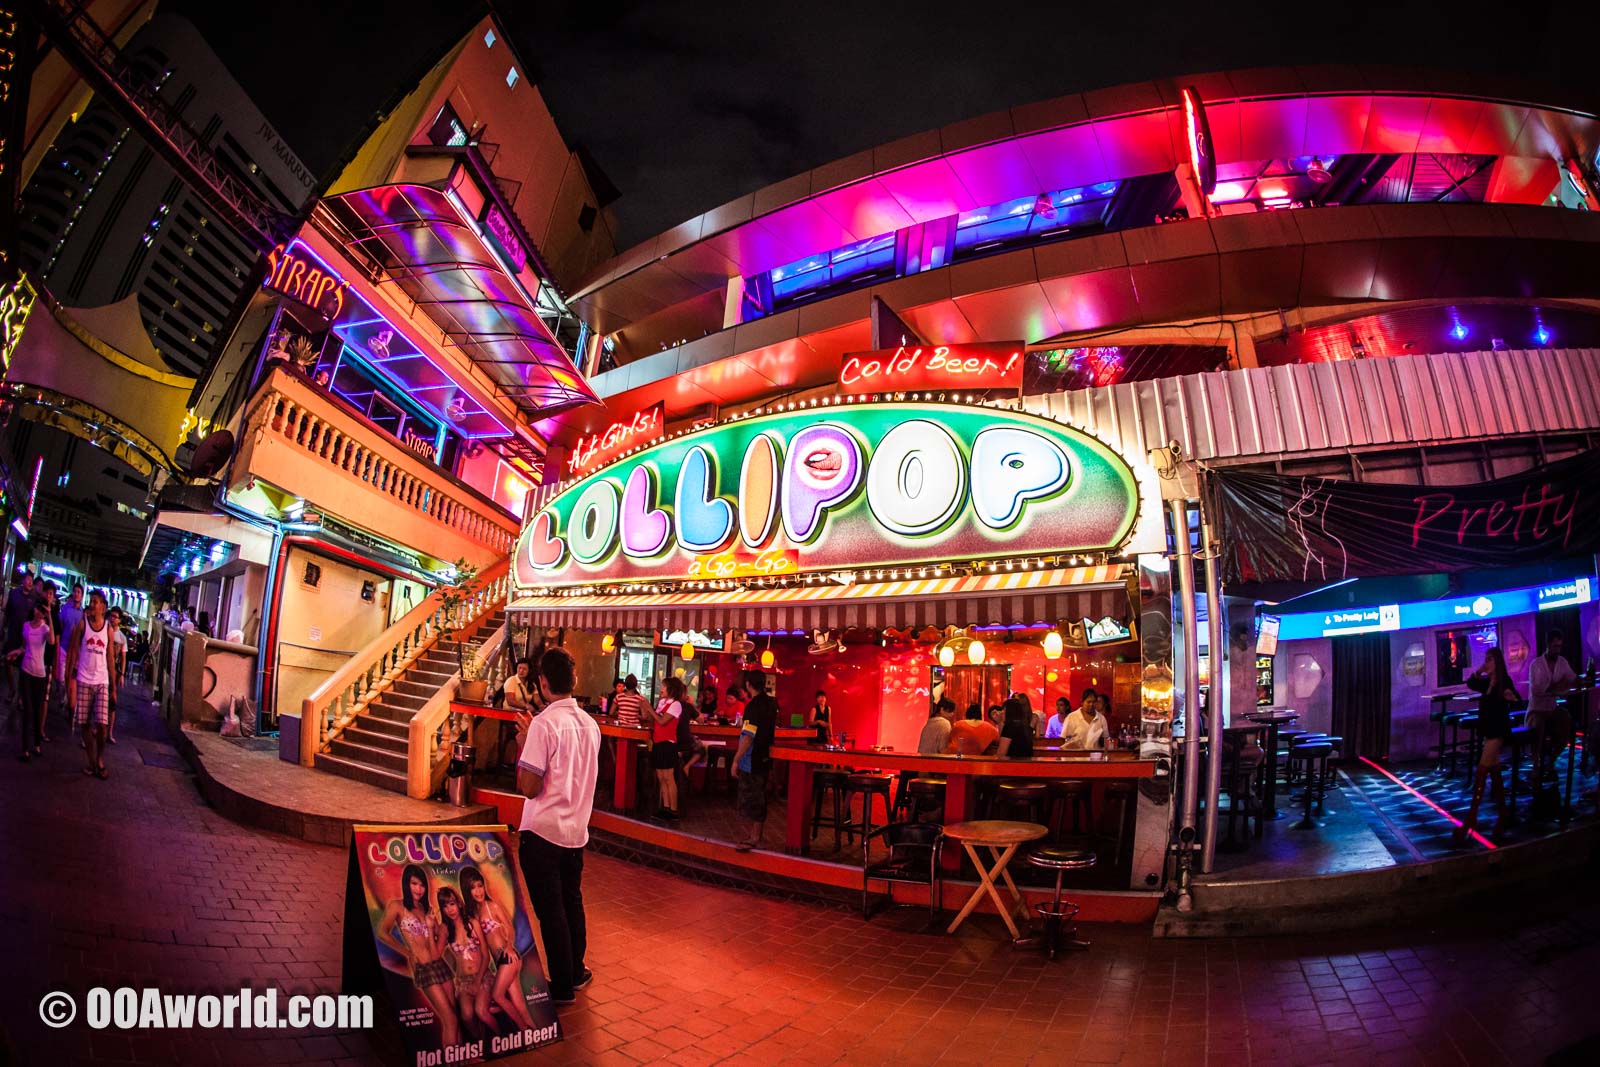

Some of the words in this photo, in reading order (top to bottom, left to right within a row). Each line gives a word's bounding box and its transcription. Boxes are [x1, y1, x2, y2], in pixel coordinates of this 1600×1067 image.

[256, 122, 275, 142] JW
[841, 347, 922, 385] Cold
[926, 346, 1019, 377] Beer!
[567, 433, 599, 474] Hot
[601, 407, 659, 450] Girls!
[528, 419, 1071, 570] LOLLIPOP
[1412, 485, 1580, 549] Pretty
[368, 833, 503, 864] LOLLIPOP
[416, 1049, 441, 1067] Hot
[444, 1040, 483, 1064] Girls!
[491, 1031, 522, 1054] Cold
[524, 1022, 557, 1046] Beer!
